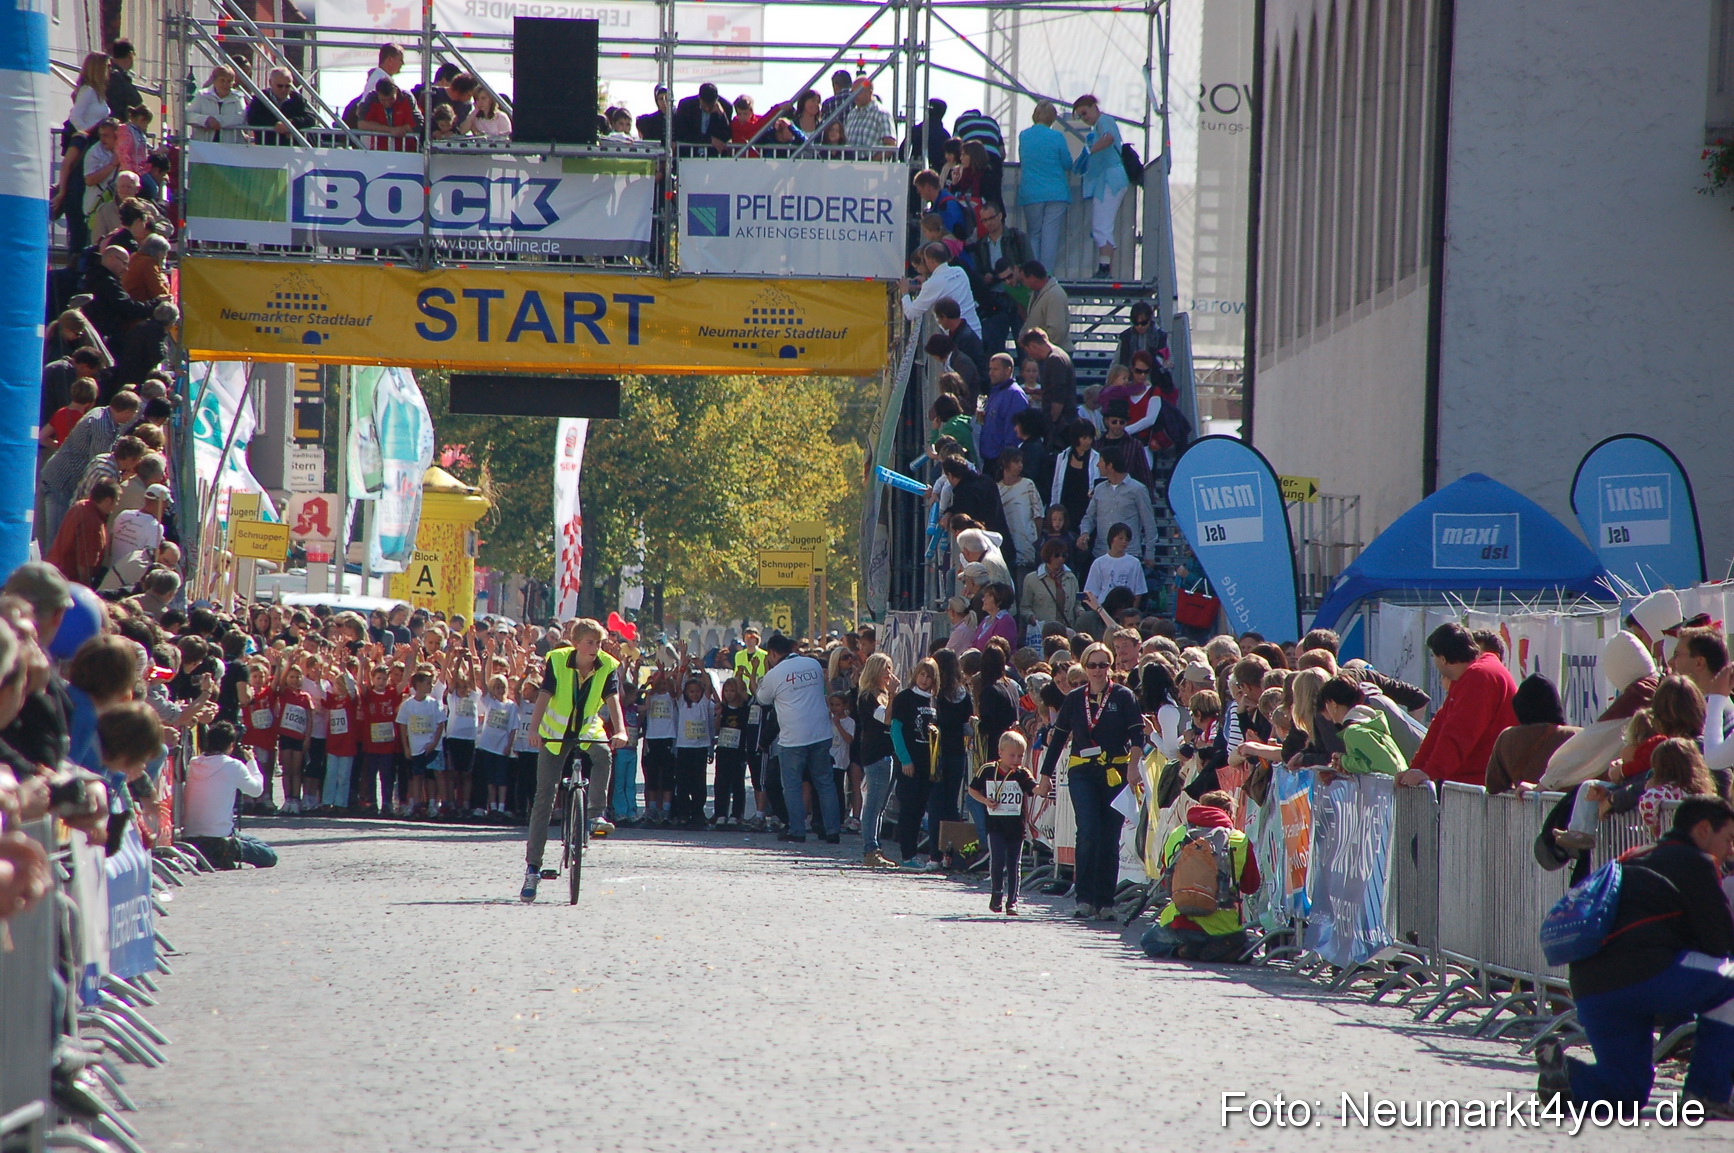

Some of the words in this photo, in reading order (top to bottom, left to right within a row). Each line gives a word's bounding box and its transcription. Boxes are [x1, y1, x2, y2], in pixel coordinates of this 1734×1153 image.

[292, 169, 562, 231] BOCK
[736, 194, 894, 225] PFLEIDERER
[735, 226, 894, 243] AKTIENGESELLSCHAFT
[418, 237, 560, 253] www.bockonline.de
[220, 308, 303, 323] Neumarkter
[307, 313, 373, 326] Stadtlauf
[414, 287, 656, 346] START
[698, 326, 780, 339] Neumarkter
[784, 327, 848, 340] Stadtlauf
[237, 529, 285, 543] Schnupper-
[1441, 524, 1500, 545] maxi
[414, 551, 439, 562] Block
[1481, 547, 1509, 560] dsl
[761, 560, 811, 570] Schnupper-
[416, 565, 434, 588] A
[777, 571, 794, 579] lauf
[777, 615, 787, 630] C
